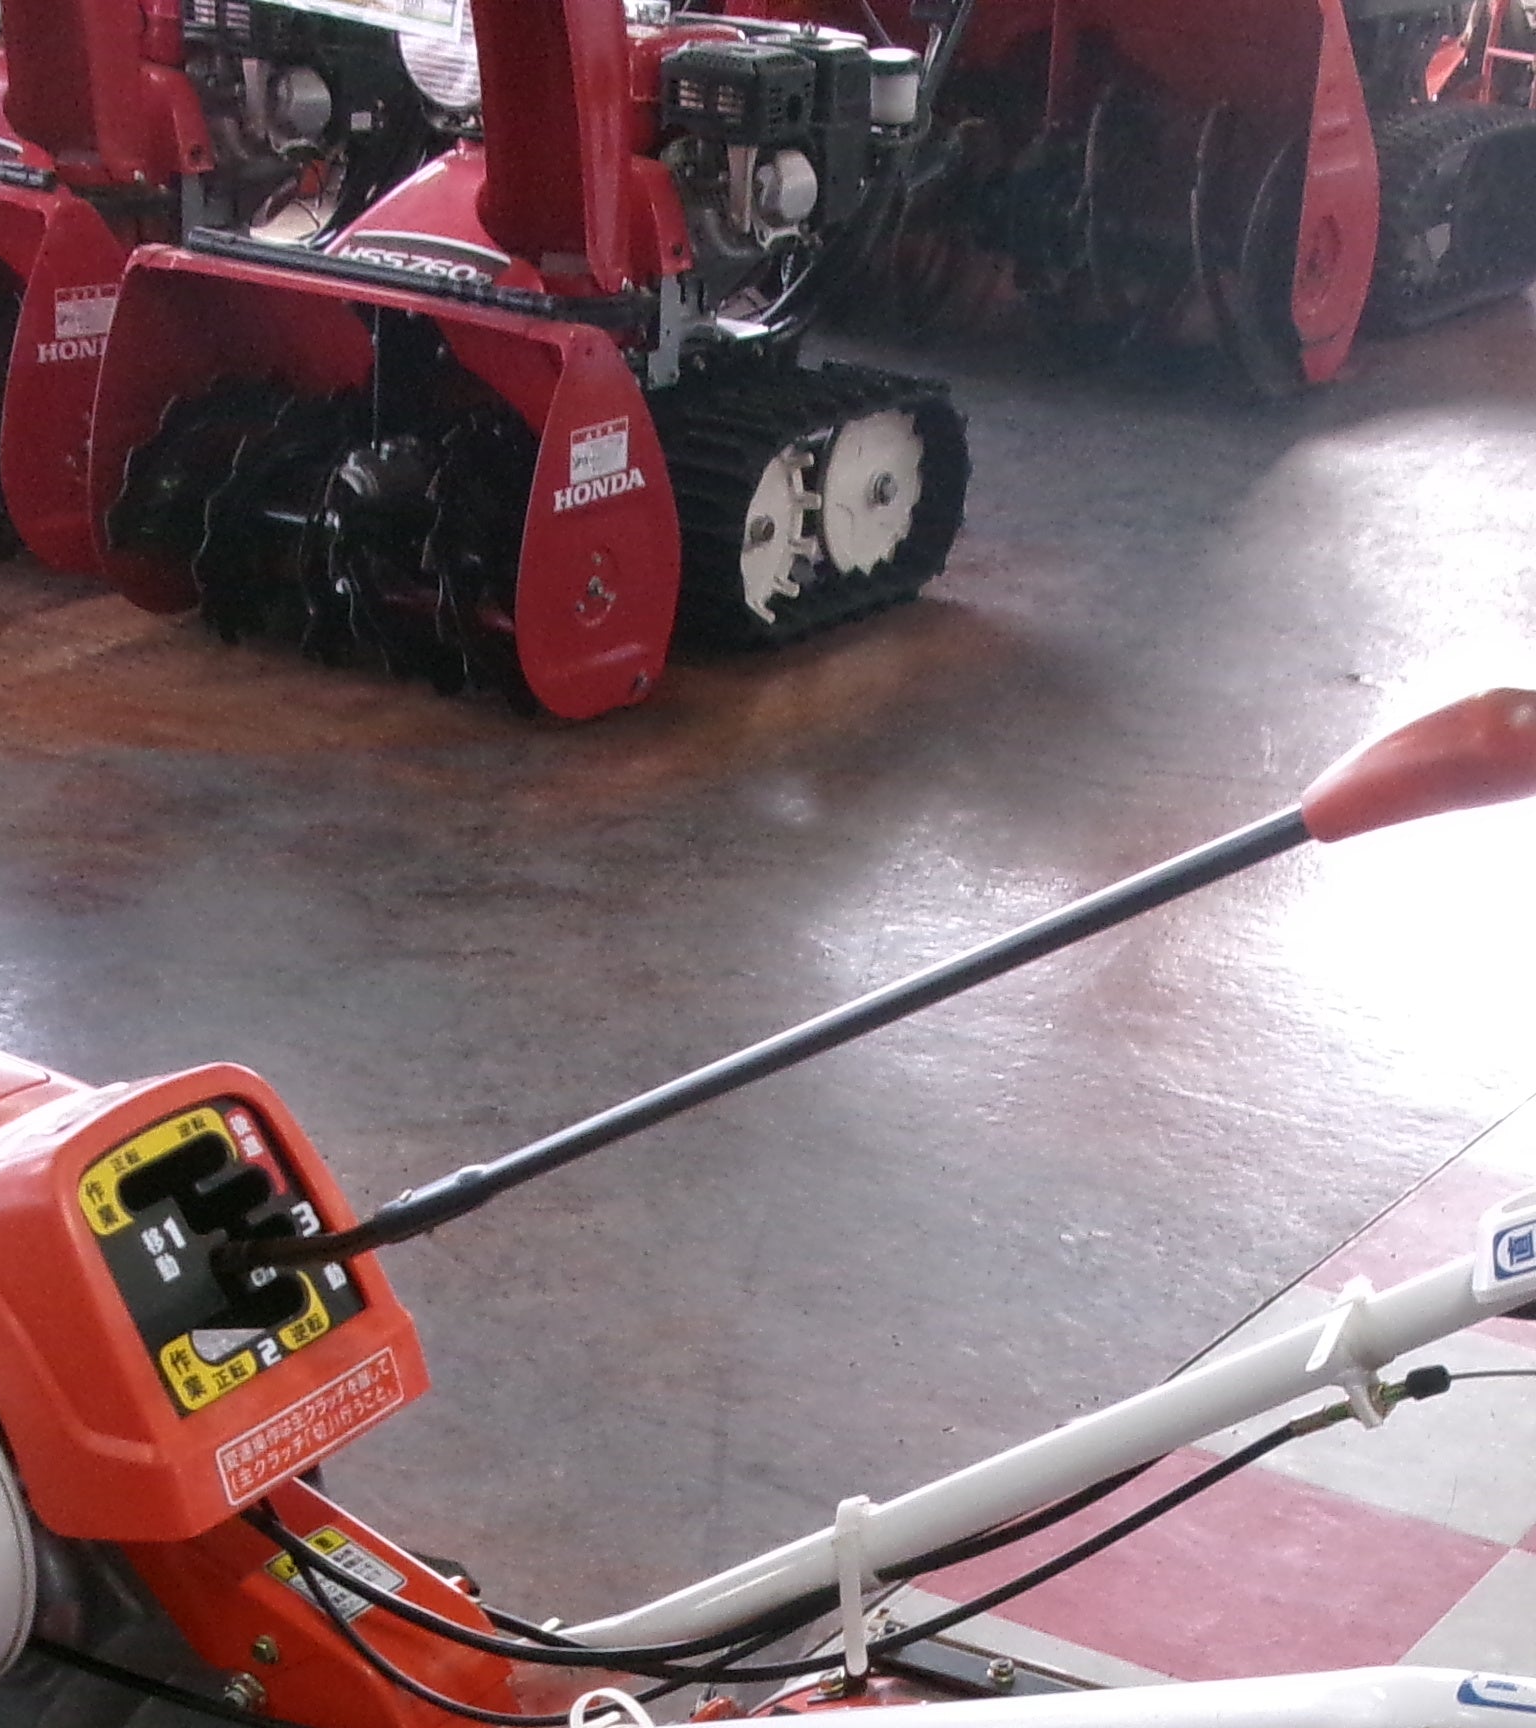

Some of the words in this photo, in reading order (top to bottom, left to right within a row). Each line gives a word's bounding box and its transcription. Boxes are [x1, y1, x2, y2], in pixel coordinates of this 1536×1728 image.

[37, 336, 108, 363] HON
[553, 467, 646, 513] HONDA
[111, 1147, 141, 1172] 正転
[85, 1179, 119, 1229] 作業
[290, 1200, 321, 1238] 3
[163, 1215, 187, 1249] 1
[291, 1312, 324, 1345] 逆転
[257, 1337, 283, 1367] 2
[169, 1348, 206, 1401] 作業
[211, 1361, 246, 1389] 正転
